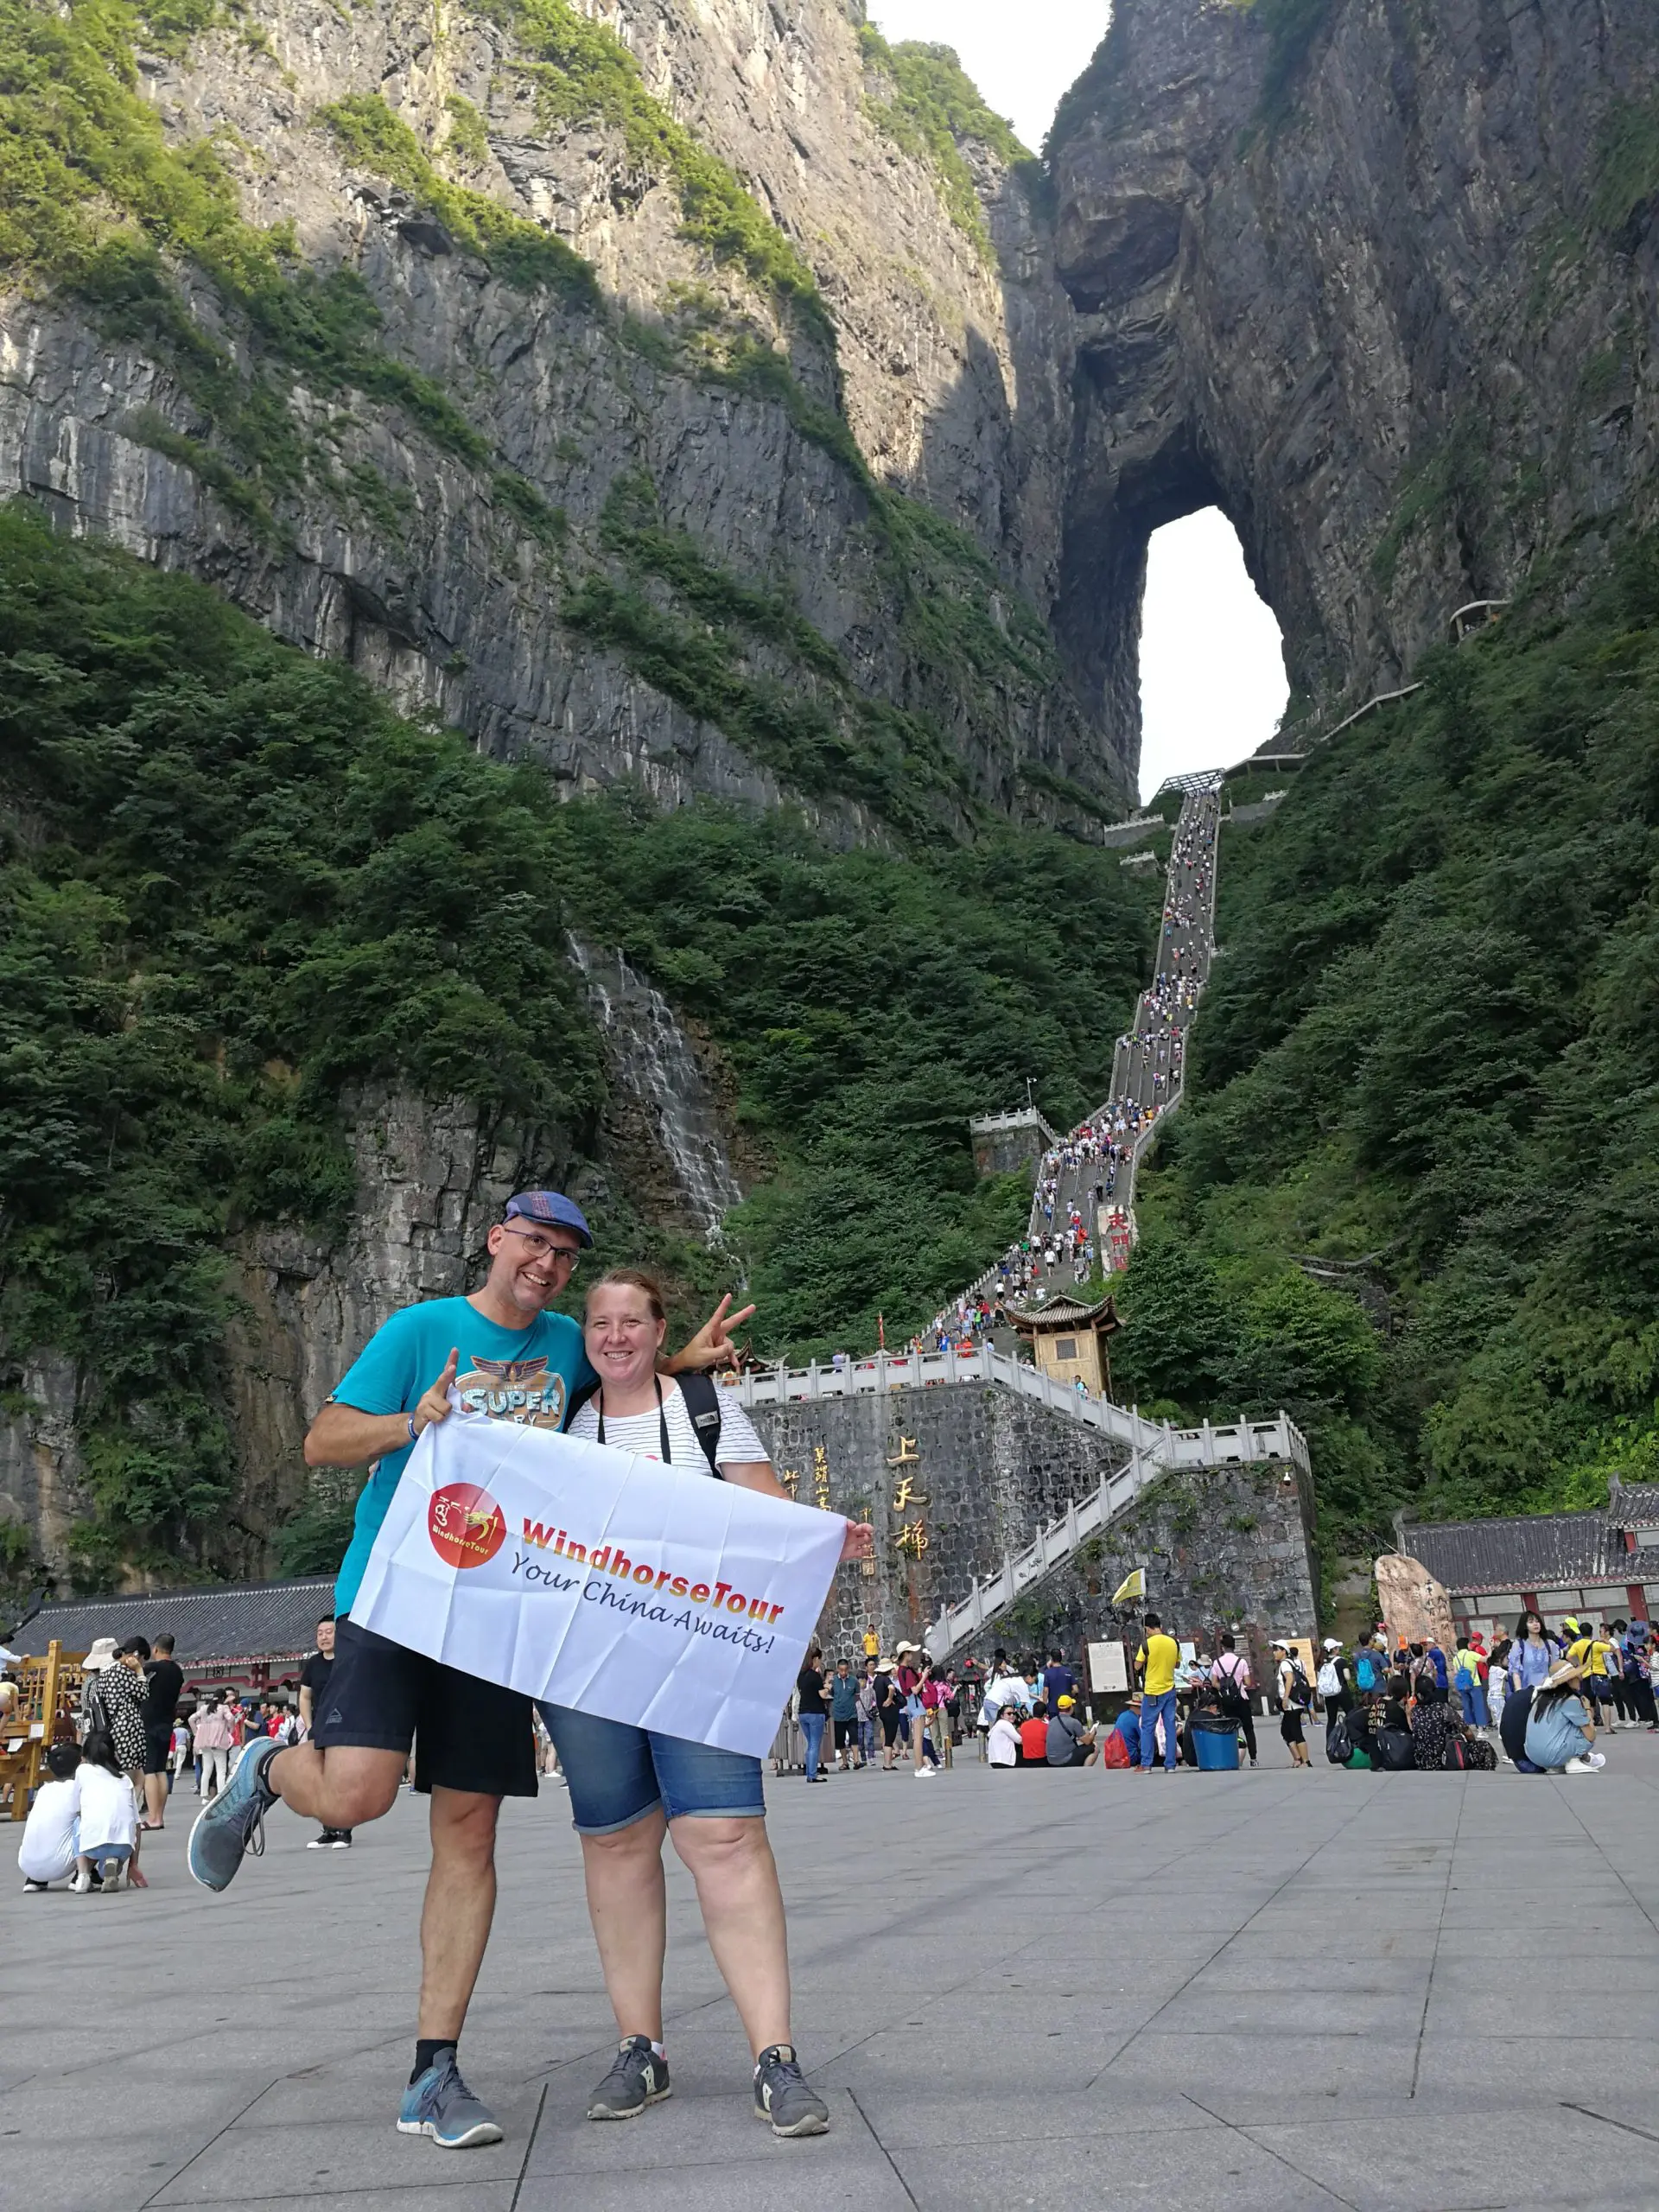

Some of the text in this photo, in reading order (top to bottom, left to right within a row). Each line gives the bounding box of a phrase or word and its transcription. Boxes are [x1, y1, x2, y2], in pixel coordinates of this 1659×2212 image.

[461, 1388, 561, 1417] SUPER
[432, 1524, 489, 1554] WindhorseTour
[887, 1436, 929, 1560] 上天梯
[512, 1552, 775, 1654] Your China Awaits!
[524, 1517, 784, 1624] WindhorseTour
